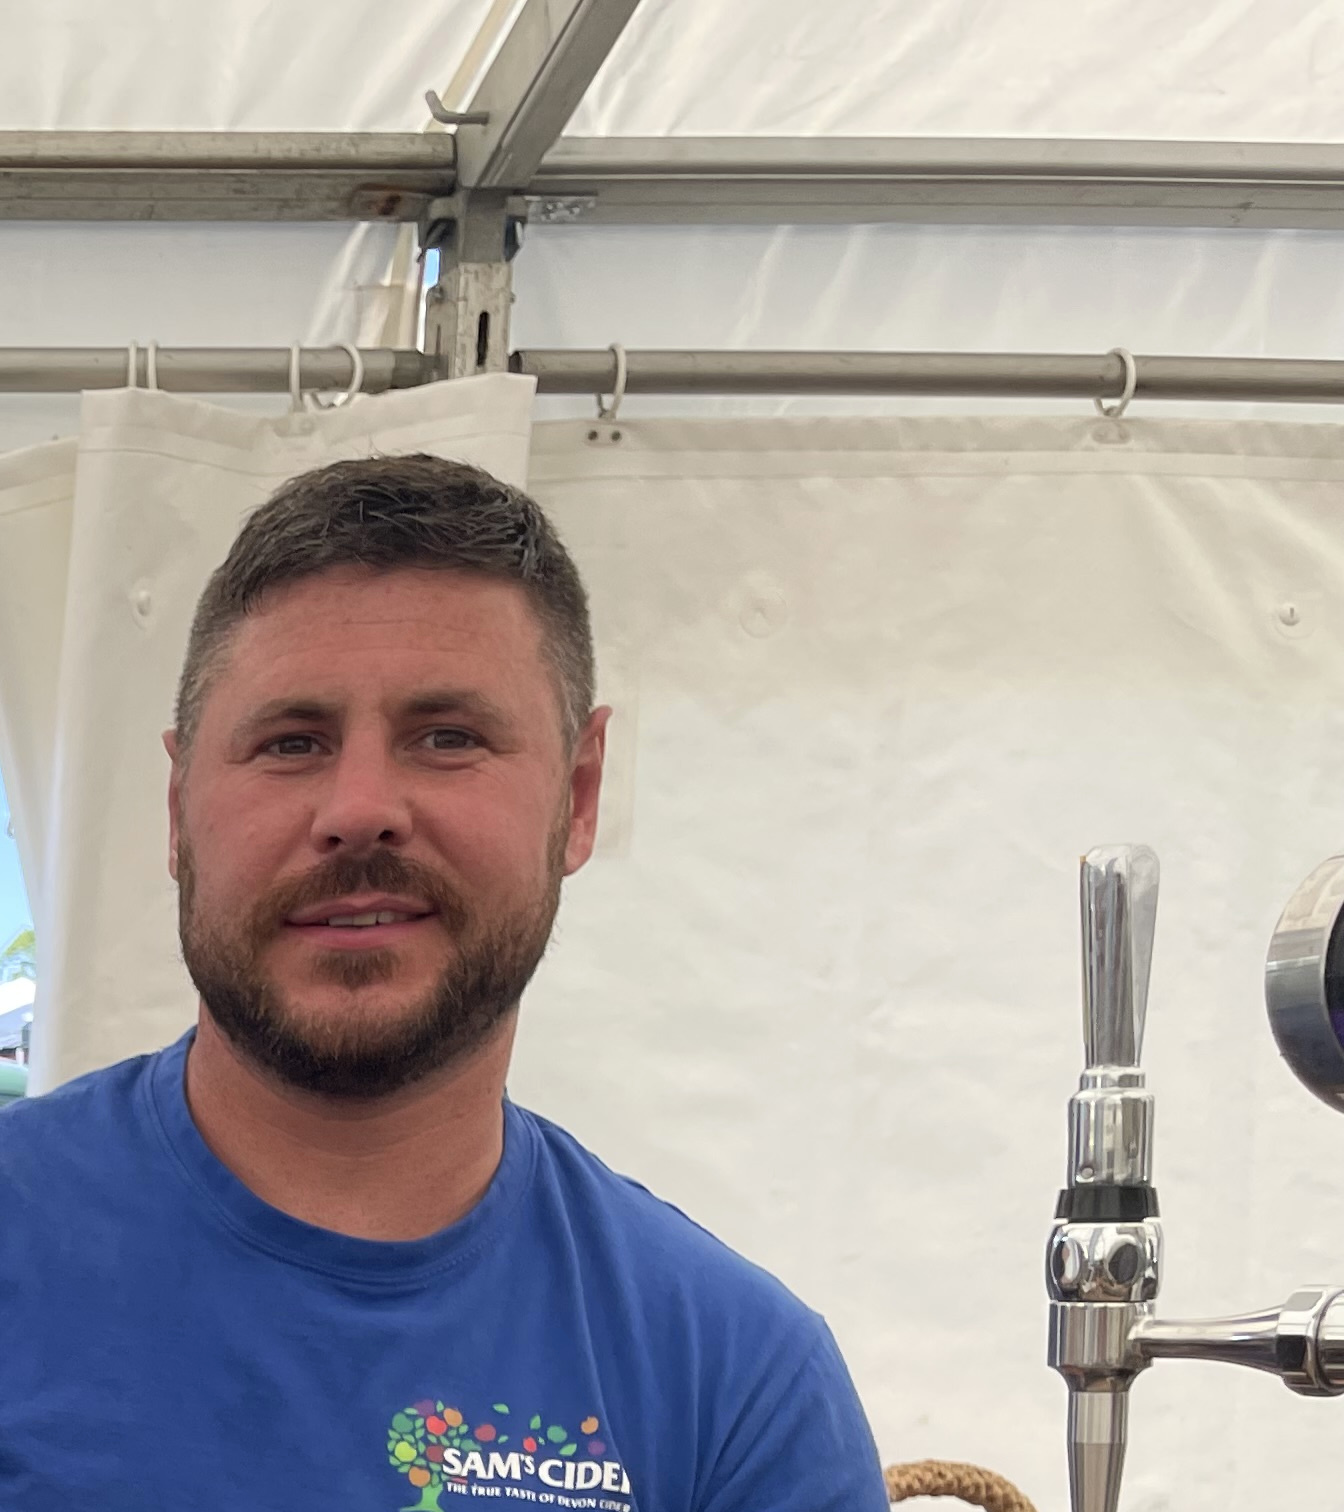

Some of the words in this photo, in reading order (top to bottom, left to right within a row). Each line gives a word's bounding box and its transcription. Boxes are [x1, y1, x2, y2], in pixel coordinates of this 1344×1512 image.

[446, 1482, 468, 1495] THE
[471, 1482, 501, 1498] TRUE
[505, 1487, 536, 1502] TASTE
[539, 1493, 555, 1505] OF
[557, 1496, 597, 1510] DEVON
